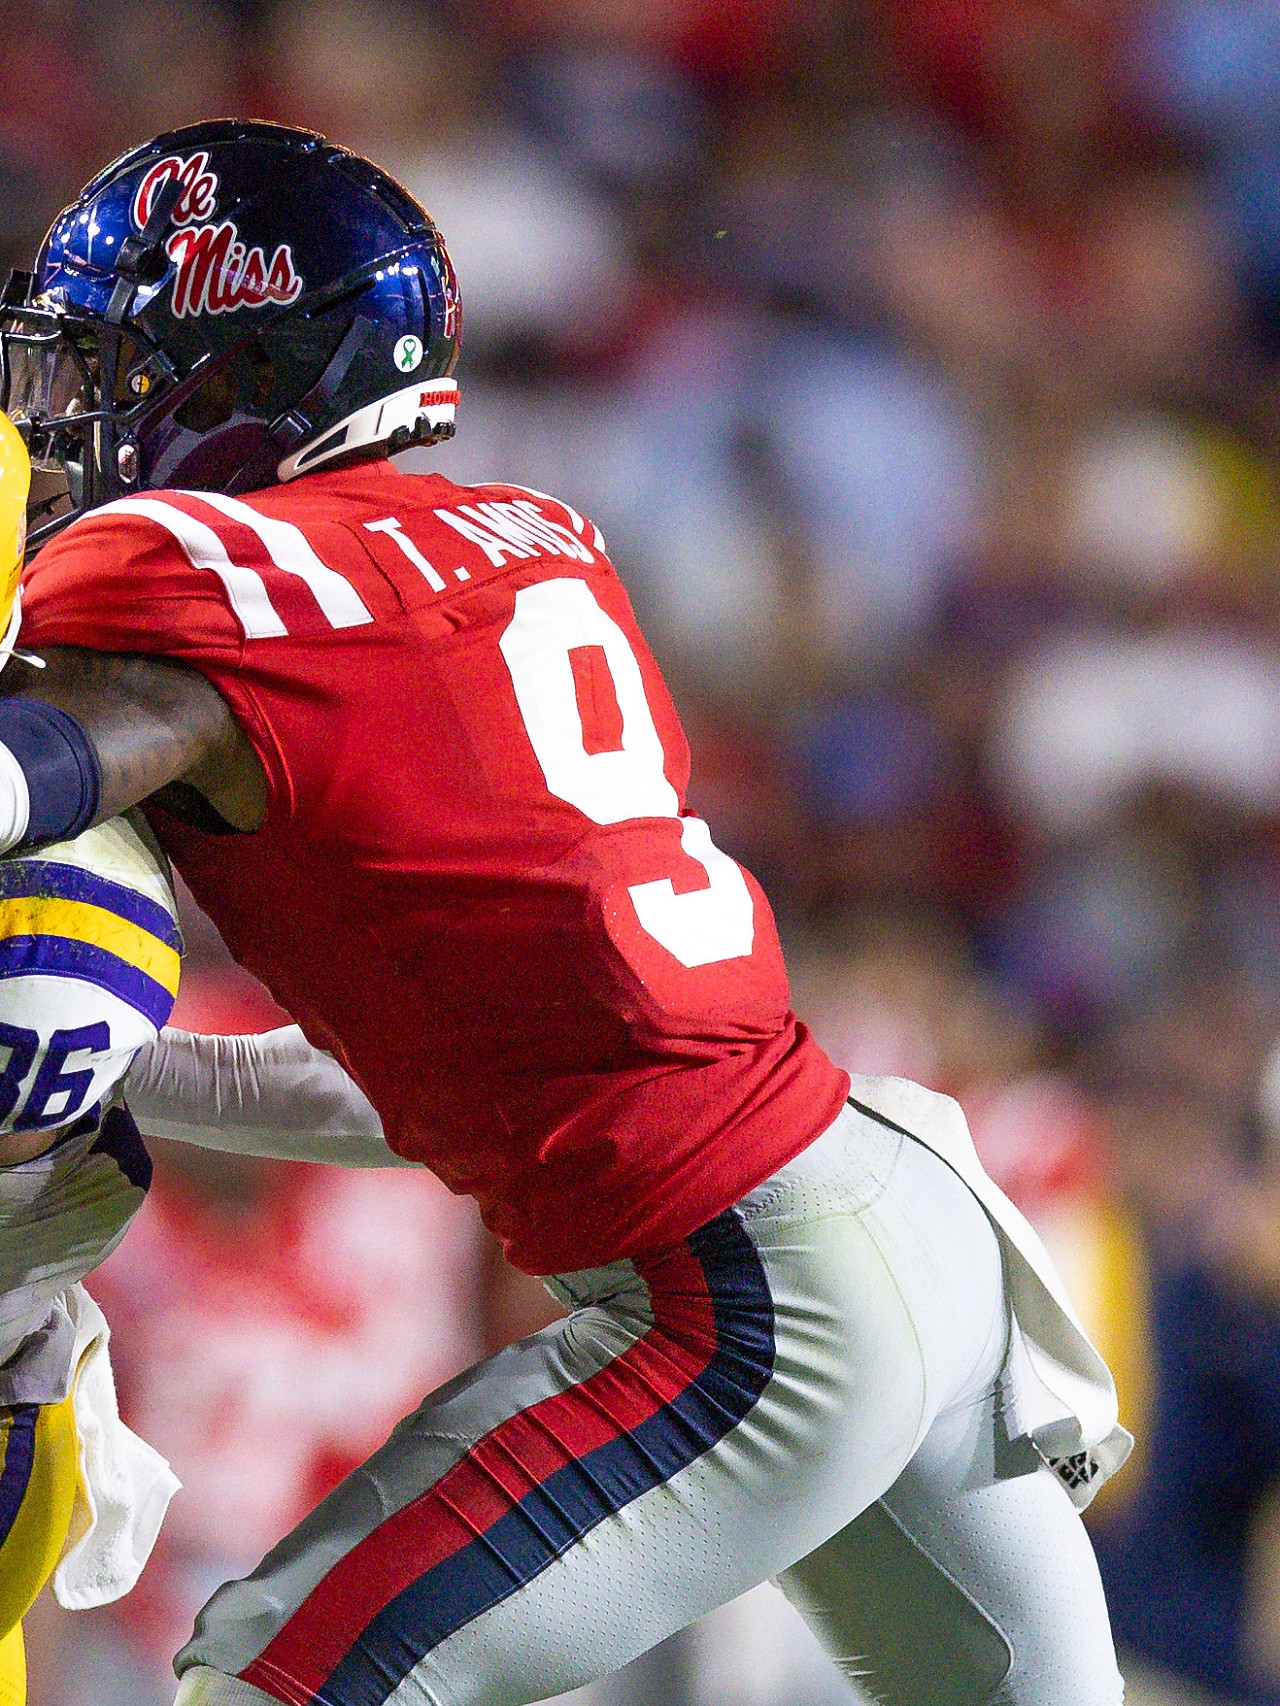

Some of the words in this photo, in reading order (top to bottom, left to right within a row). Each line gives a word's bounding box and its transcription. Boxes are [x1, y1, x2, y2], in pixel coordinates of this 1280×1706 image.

[134, 152, 218, 231] Ole
[166, 222, 303, 319] Miss
[363, 516, 472, 593] T.
[433, 499, 595, 568] AMOS
[499, 577, 755, 969] 9
